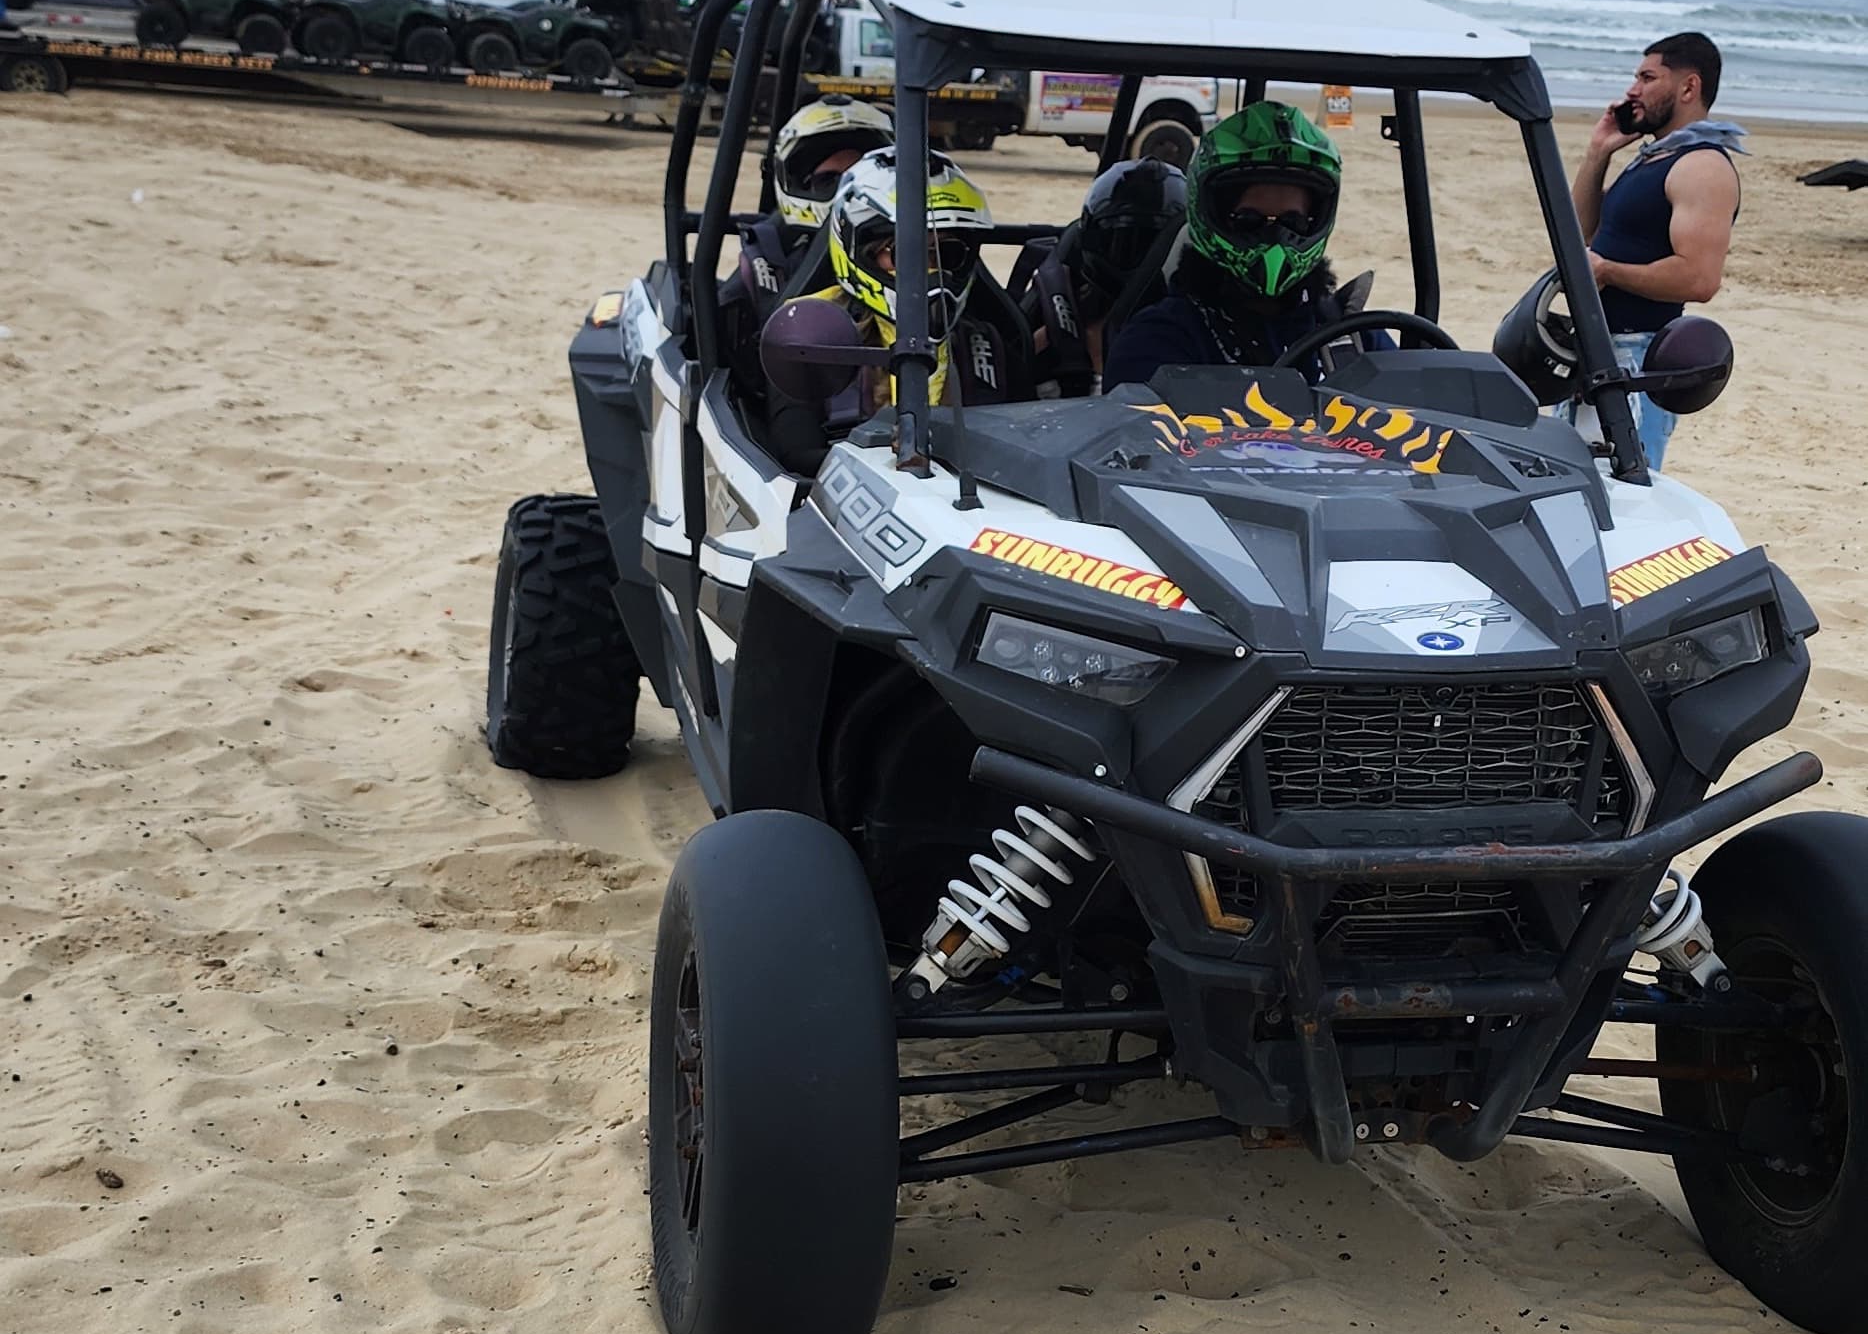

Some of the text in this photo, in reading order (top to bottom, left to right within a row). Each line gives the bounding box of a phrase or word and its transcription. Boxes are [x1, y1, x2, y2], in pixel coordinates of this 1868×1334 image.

[1328, 97, 1350, 112] NO
[818, 455, 927, 568] 1000
[969, 530, 1184, 609] SUNBUGGY
[1608, 537, 1733, 605] SUNBUGGY
[1330, 599, 1506, 633] RZR
[1443, 616, 1512, 629] XP
